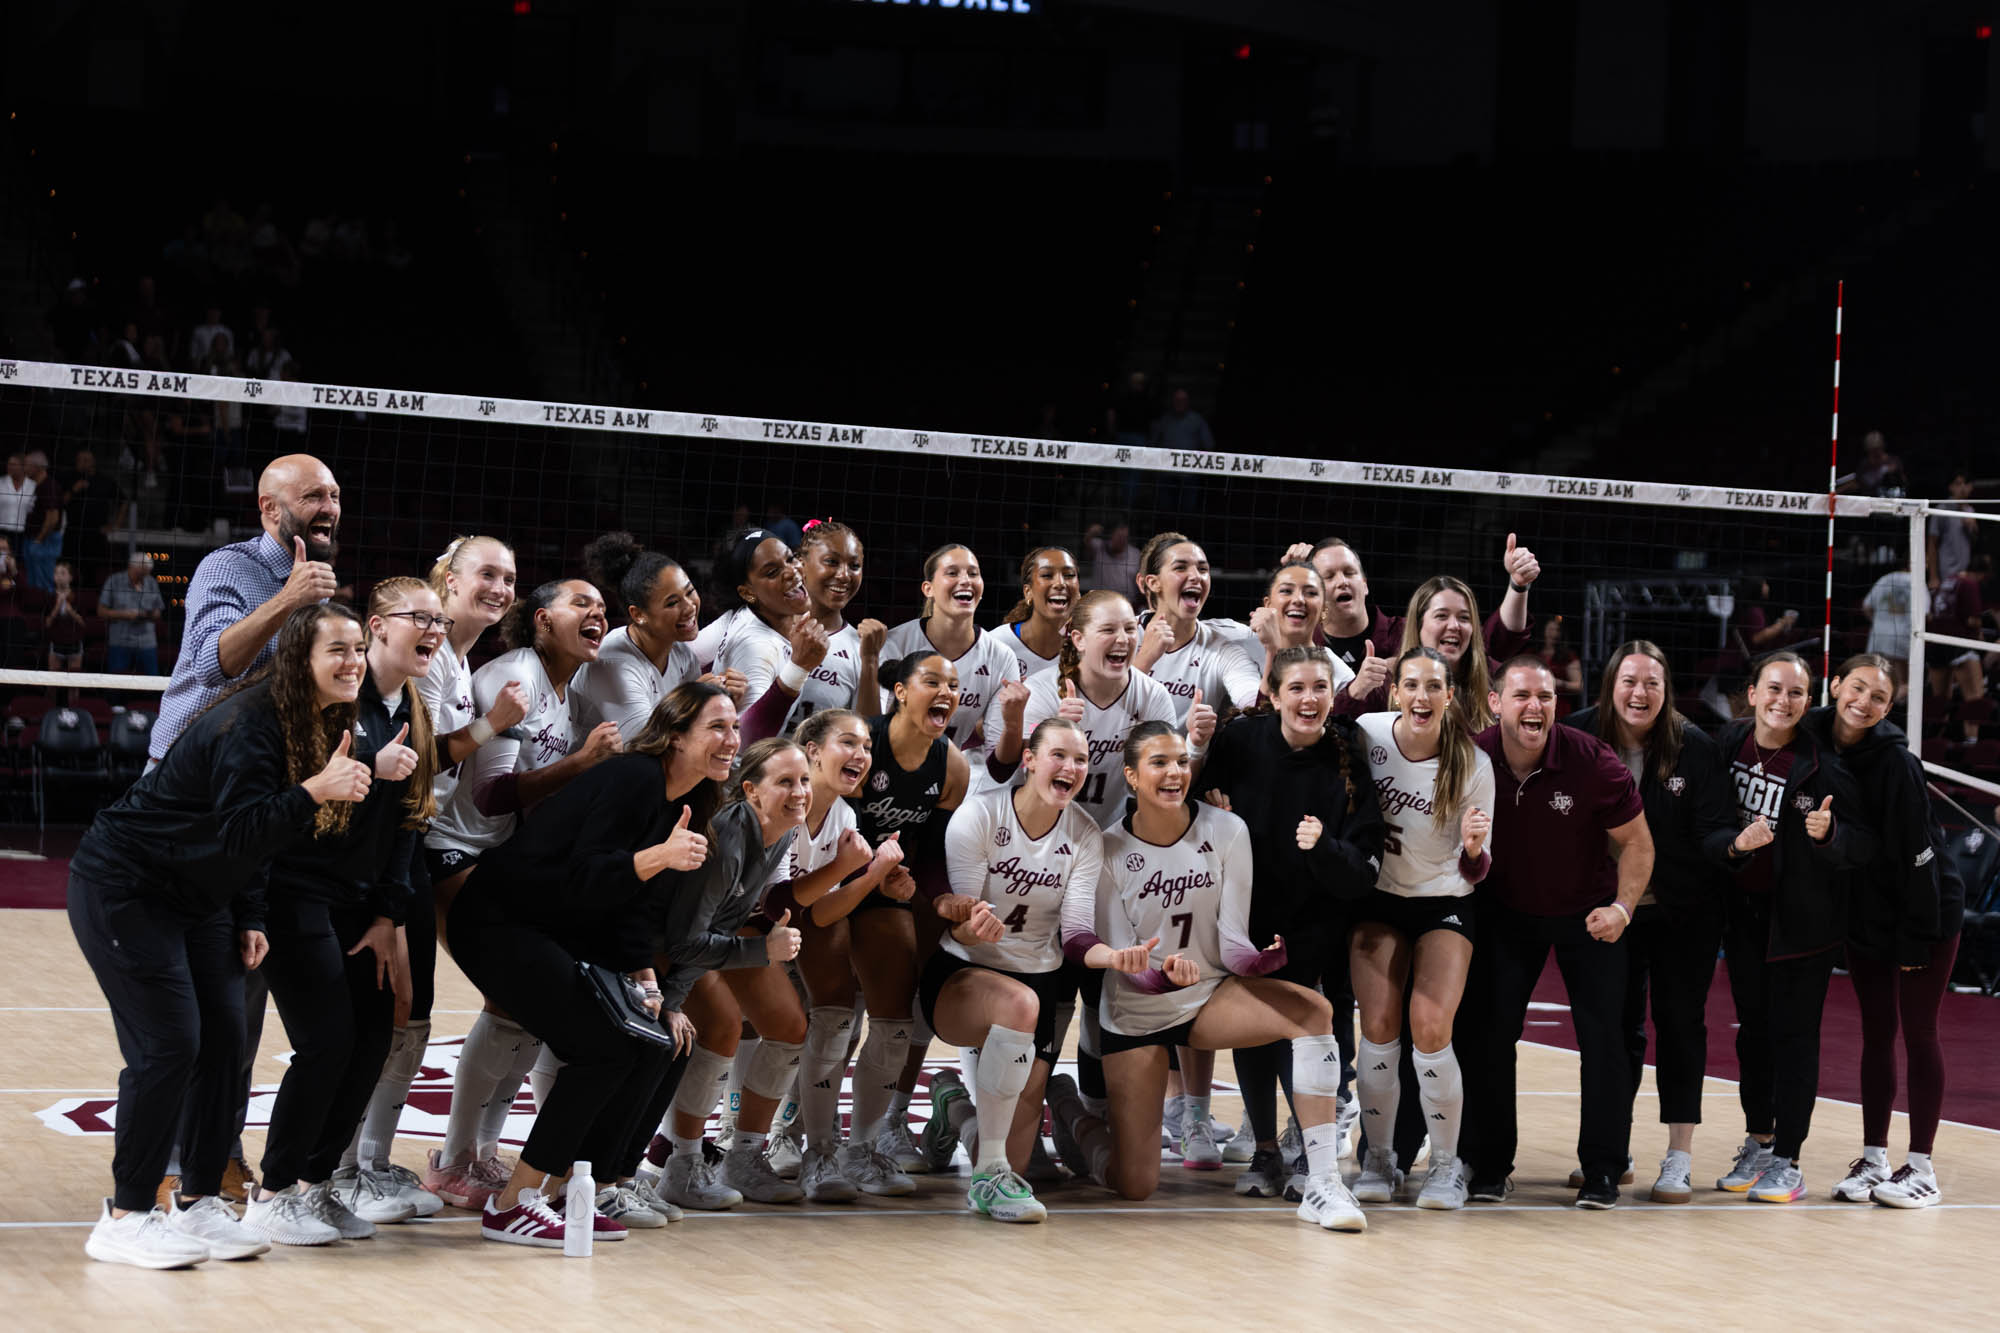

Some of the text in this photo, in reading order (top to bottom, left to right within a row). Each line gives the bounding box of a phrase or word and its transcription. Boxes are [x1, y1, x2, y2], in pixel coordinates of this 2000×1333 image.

[71, 368, 188, 393] TEXAS A&M
[313, 387, 424, 411] TEXAS A&M
[543, 405, 649, 428] TEXAS A&M
[762, 422, 864, 444] TEXAS A&M
[971, 438, 1069, 459] TEXAS A&M
[1170, 452, 1264, 473] TEXAS A&M
[1362, 466, 1453, 486] TEXAS A&M
[1547, 479, 1634, 498] TEXAS A&M
[1725, 491, 1809, 510] TEXAS A&M
[531, 723, 568, 763] Aggies
[863, 796, 932, 828] Aggie
[1384, 822, 1404, 856] 5
[1127, 854, 1144, 871] SEC
[989, 856, 1062, 897] Aggies
[1138, 869, 1214, 909] Aggies
[1003, 903, 1029, 933] 4
[1171, 912, 1193, 950] 7
